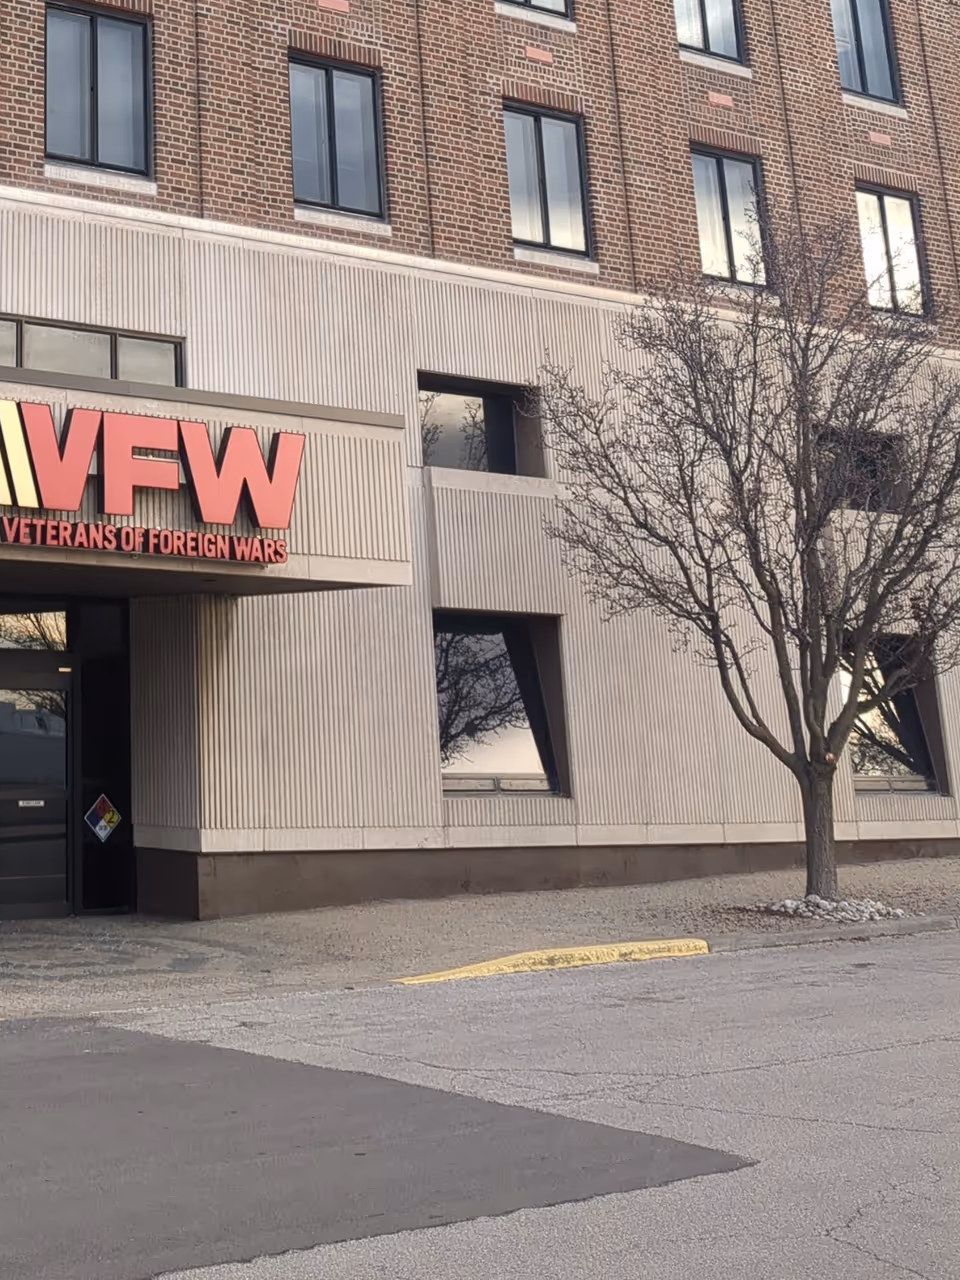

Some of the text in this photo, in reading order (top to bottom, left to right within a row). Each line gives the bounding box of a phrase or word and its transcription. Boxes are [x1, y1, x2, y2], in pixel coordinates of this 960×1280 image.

[16, 401, 306, 530] VFW
[0, 515, 288, 564] VETERANS OF FOREIGN WARS
